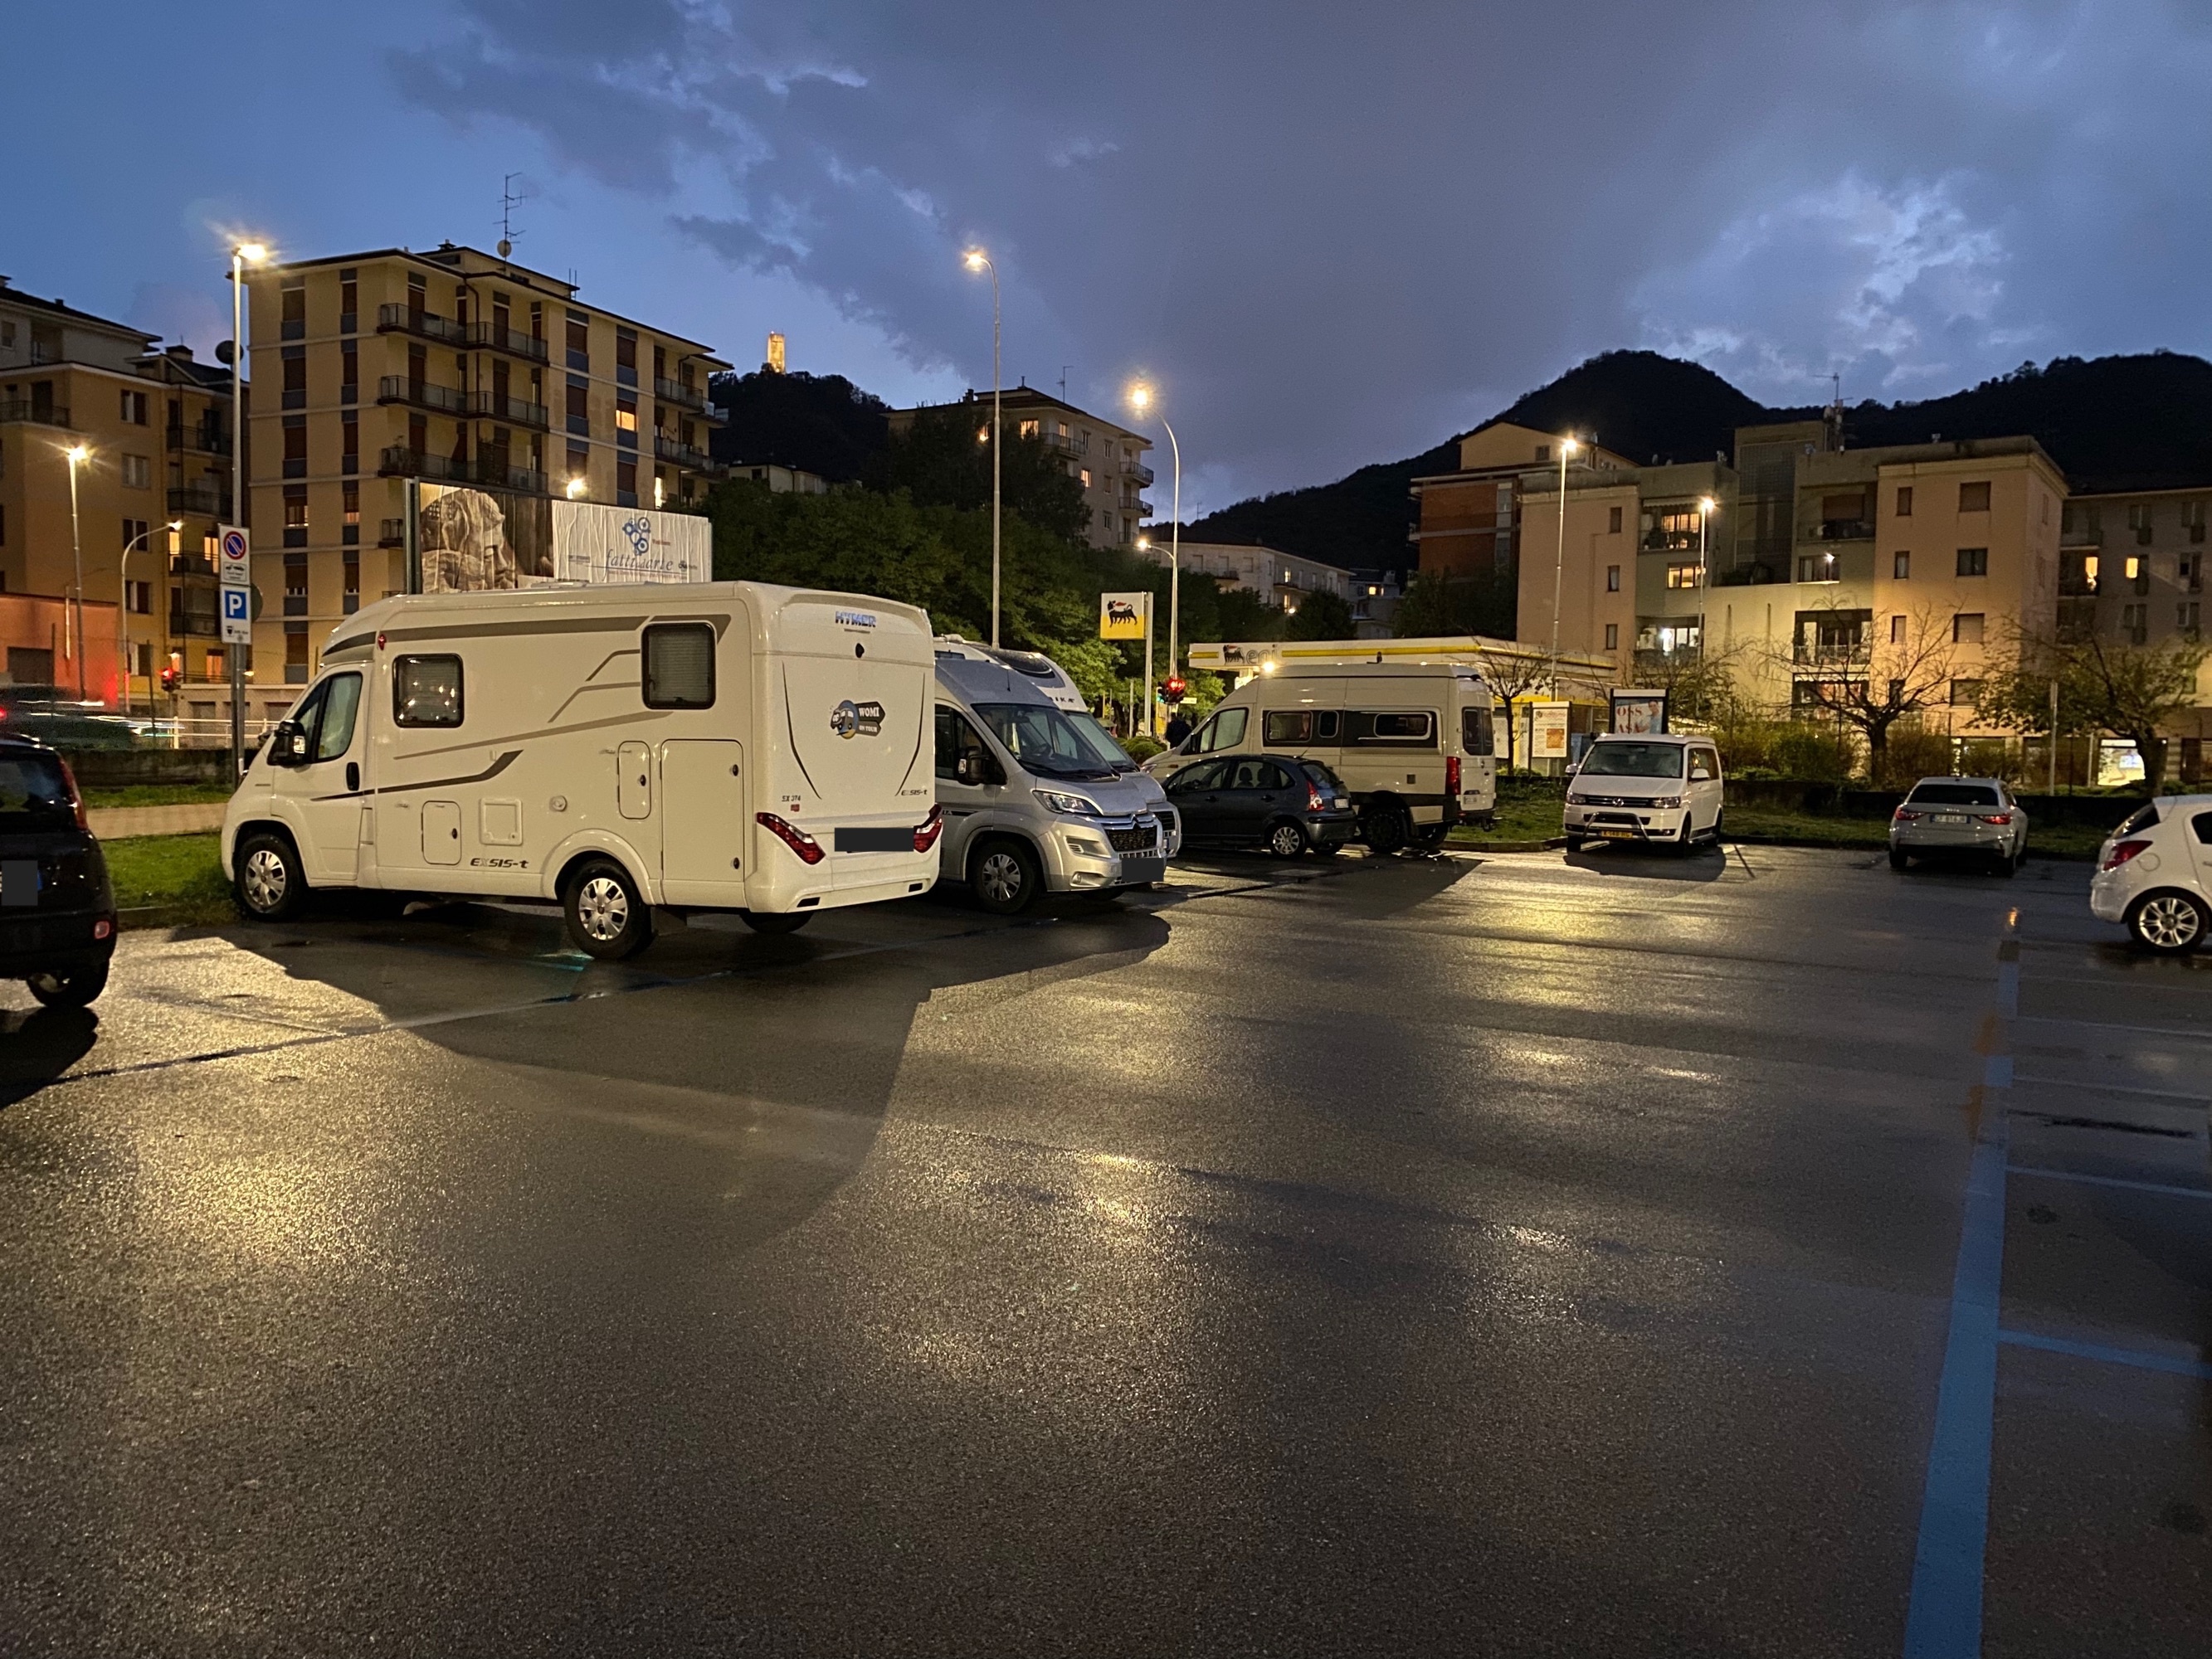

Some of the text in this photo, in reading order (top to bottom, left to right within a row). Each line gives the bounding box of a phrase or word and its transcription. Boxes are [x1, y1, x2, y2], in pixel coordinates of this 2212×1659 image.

[229, 594, 242, 615] P
[836, 611, 876, 627] HYMER
[1246, 644, 1277, 664] eni
[858, 707, 879, 718] WOMI
[470, 857, 529, 869] EXSIS-t
